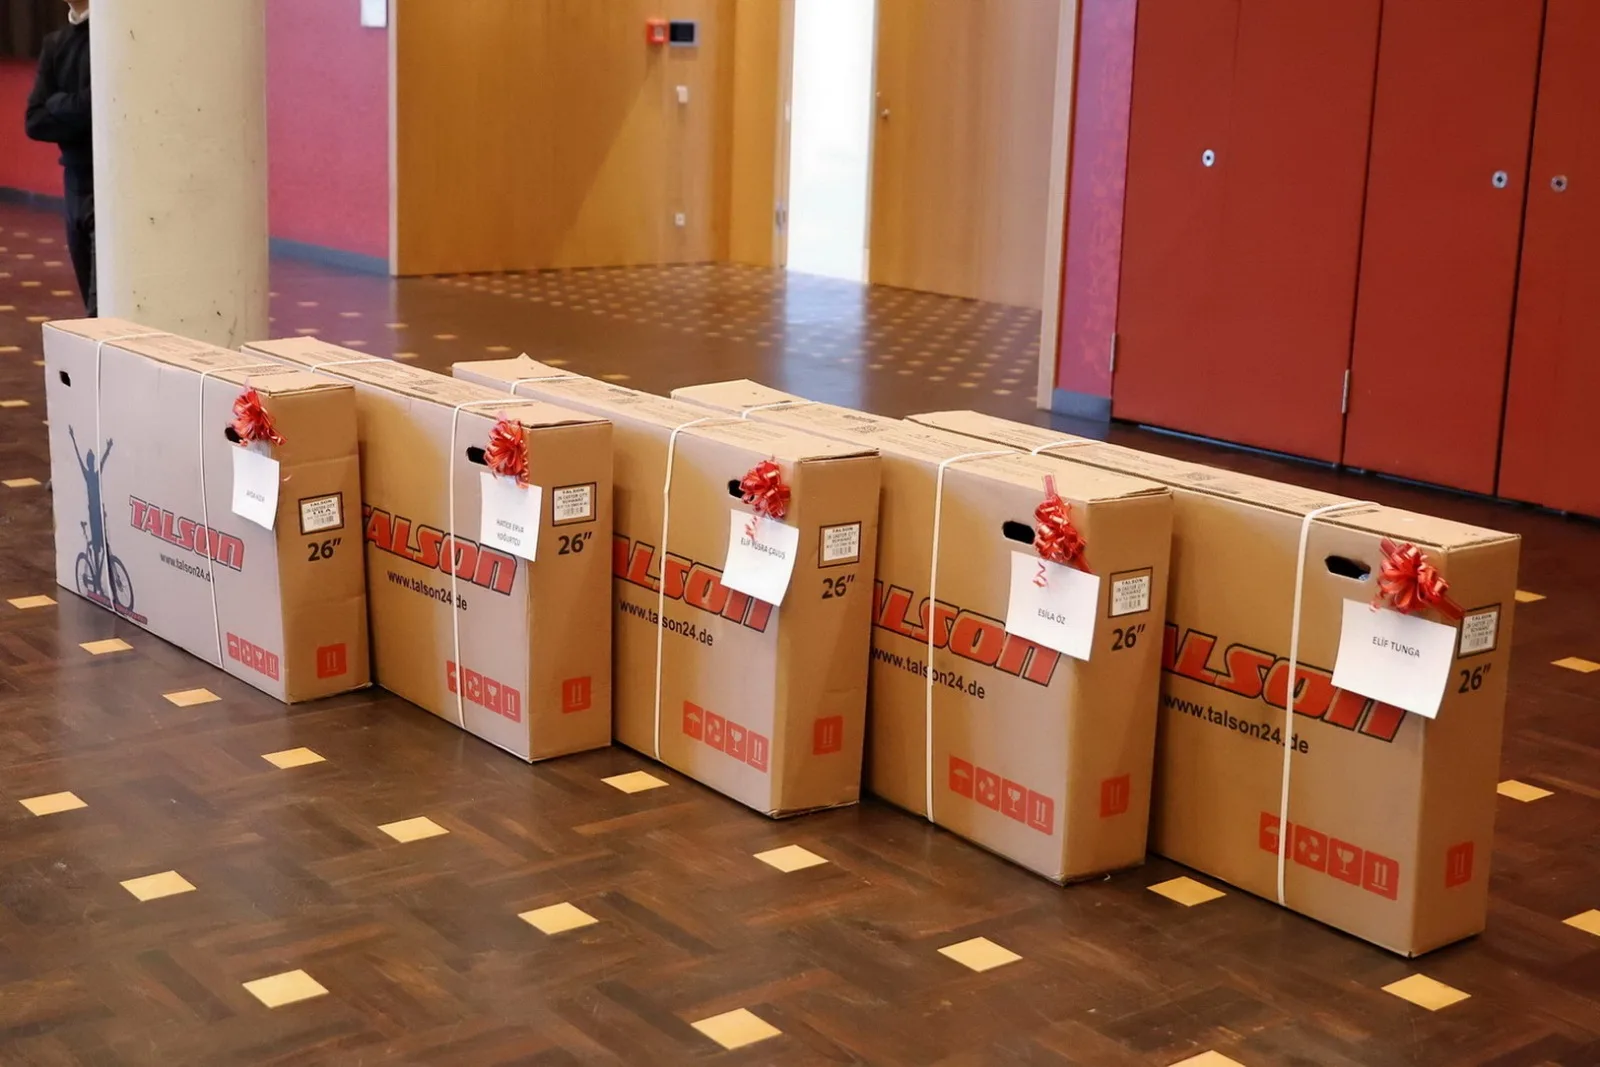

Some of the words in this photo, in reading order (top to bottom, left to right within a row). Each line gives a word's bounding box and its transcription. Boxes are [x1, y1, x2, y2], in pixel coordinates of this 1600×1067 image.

[308, 538, 341, 562] 26"
[362, 503, 518, 596] ALSON
[558, 531, 592, 555] 26"
[160, 553, 213, 582] www.talson24.d
[822, 574, 855, 599] 26"
[619, 600, 713, 646] www.tason24.de
[1111, 624, 1145, 651] 26"
[1372, 636, 1389, 648] ELİF
[1391, 641, 1420, 658] TUNGA
[1458, 663, 1491, 693] 26"
